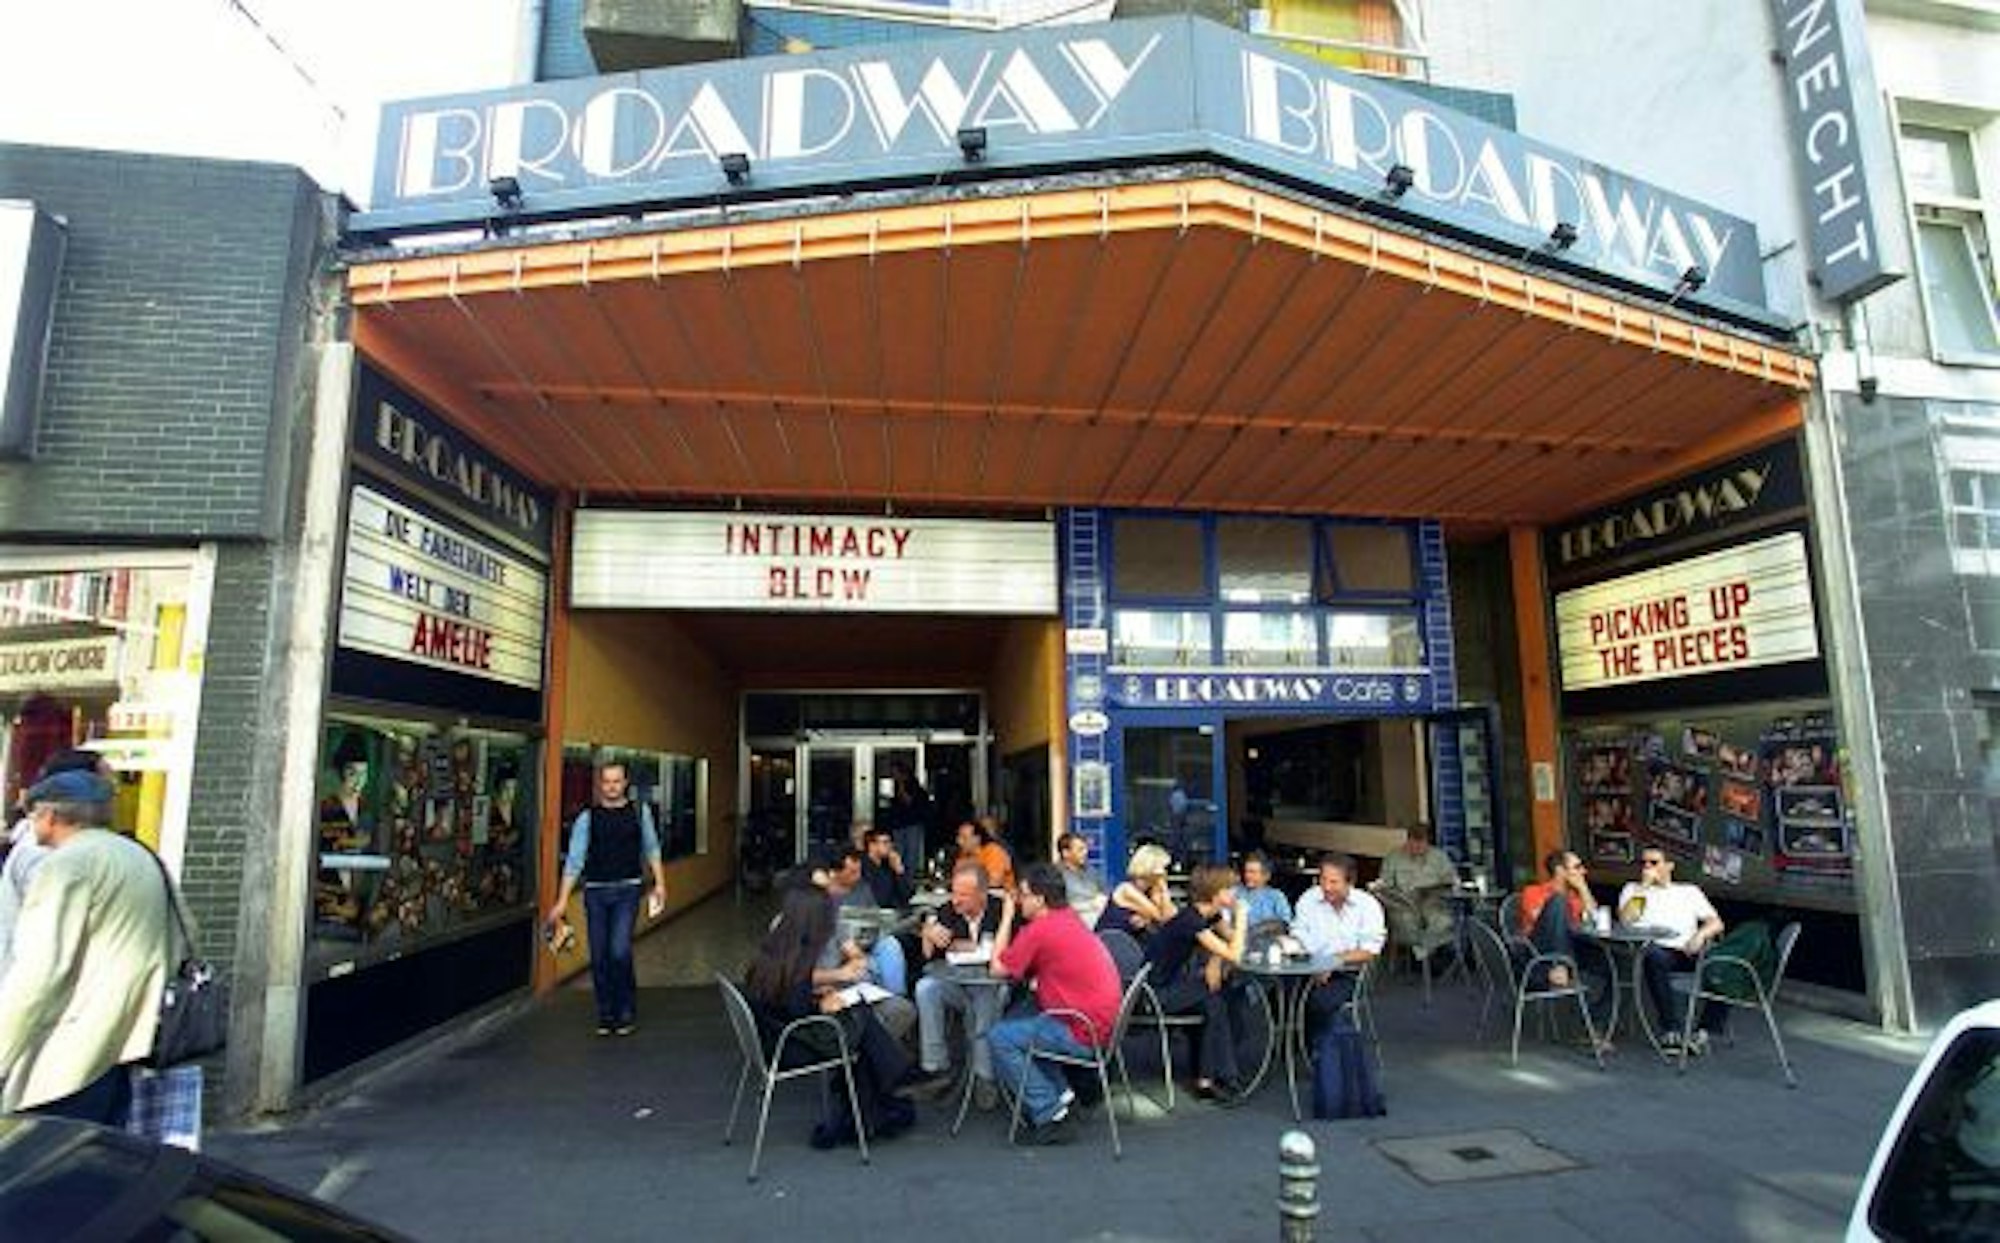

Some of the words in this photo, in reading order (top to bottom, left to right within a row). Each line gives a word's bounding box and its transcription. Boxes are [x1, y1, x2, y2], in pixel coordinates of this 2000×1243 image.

[397, 34, 1162, 197] BROADWAY
[1782, 0, 1869, 266] NECHT
[1240, 50, 1734, 282] BROADWAY
[376, 399, 539, 531] BROADWAY
[725, 523, 912, 560] INTIMACY
[1560, 461, 1773, 563] BROADWAY
[389, 564, 432, 604] WELT
[1590, 596, 1690, 646] PICKING
[1710, 582, 1750, 622] UP
[411, 611, 492, 669] AMELIE
[1600, 643, 1642, 679] THE
[1653, 626, 1749, 672] PIECES
[1154, 677, 1327, 701] BROADWAY
